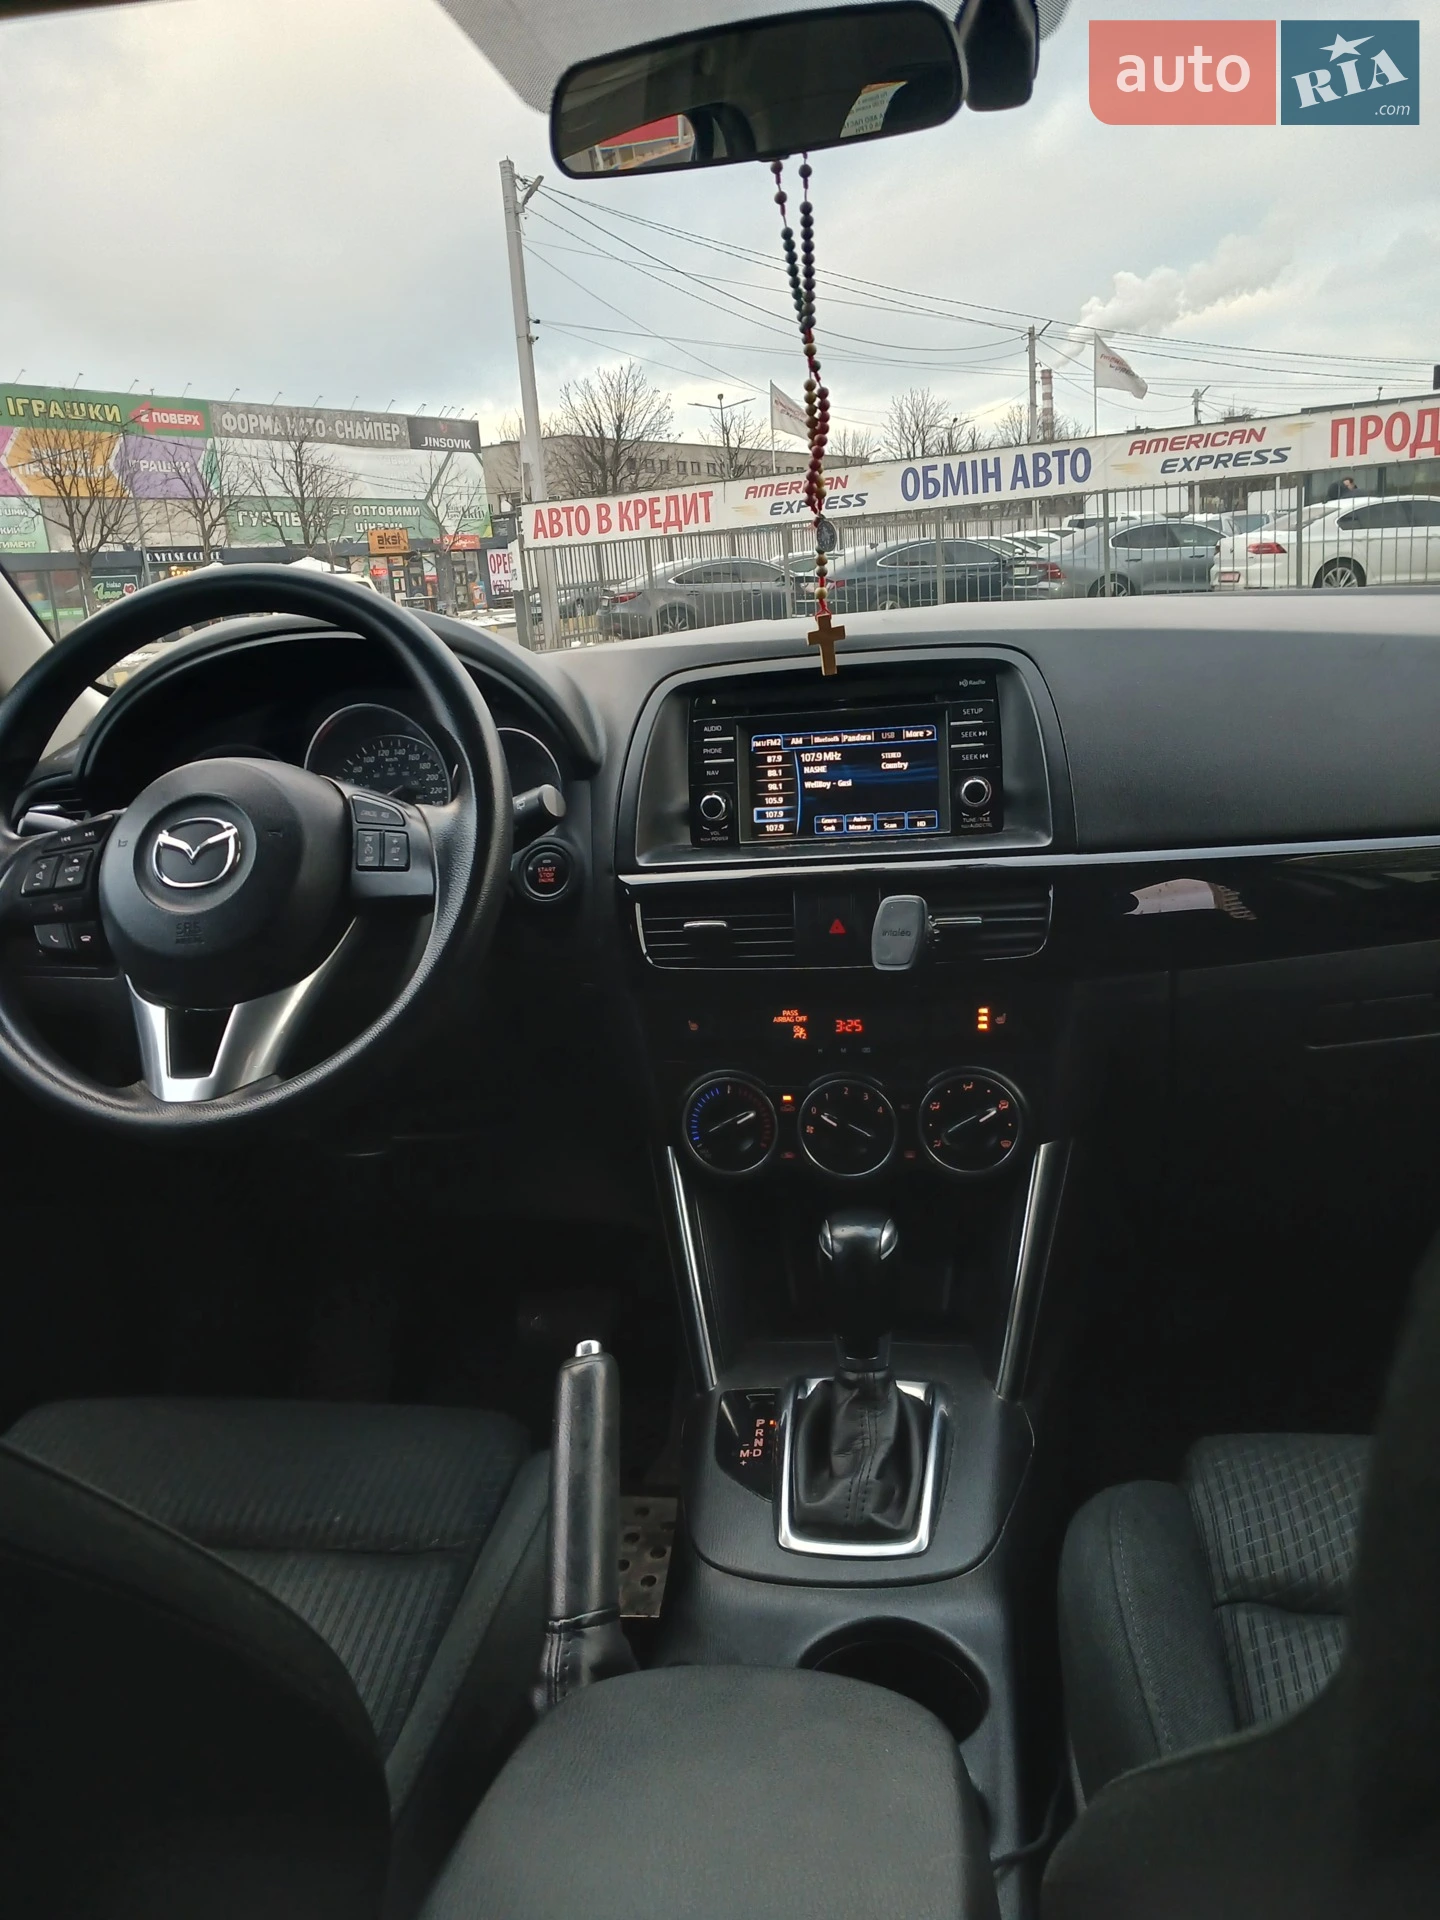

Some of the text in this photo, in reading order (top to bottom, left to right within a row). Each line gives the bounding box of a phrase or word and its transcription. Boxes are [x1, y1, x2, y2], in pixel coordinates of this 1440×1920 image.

[6, 396, 122, 423] ІГРАШКИ
[152, 411, 201, 426] ПОВЕРХ
[221, 411, 285, 436] ФОРМА
[334, 417, 401, 442] СНАЙПЕР
[421, 436, 472, 450] JINSOVIK
[1128, 427, 1267, 456] AMERICAN
[1160, 446, 1292, 474] EXPRESS
[901, 446, 1092, 502] ОБМІН АВТО
[745, 475, 849, 499] AMERAN
[770, 493, 868, 515] EXPESS
[533, 491, 714, 540] АВТО В КРЕДИТ
[187, 552, 220, 561] COEE
[962, 707, 983, 715] SETUP
[790, 737, 803, 745] AM
[843, 733, 872, 742] Pandora
[881, 731, 895, 739] USB
[905, 730, 924, 738] More
[767, 755, 783, 763] 87.9
[800, 752, 842, 762] 107.9 MHz
[803, 765, 827, 774] NASHE
[881, 761, 909, 770] Country
[765, 796, 784, 804] 105.9
[765, 810, 784, 818] 107.9
[765, 824, 785, 832] 107.9
[782, 1009, 799, 1017] PASS
[773, 1015, 794, 1023] AIRBAG
[835, 1019, 863, 1033] 3:25
[756, 1418, 766, 1428] P
[754, 1428, 764, 1436] R
[754, 1438, 764, 1447] N
